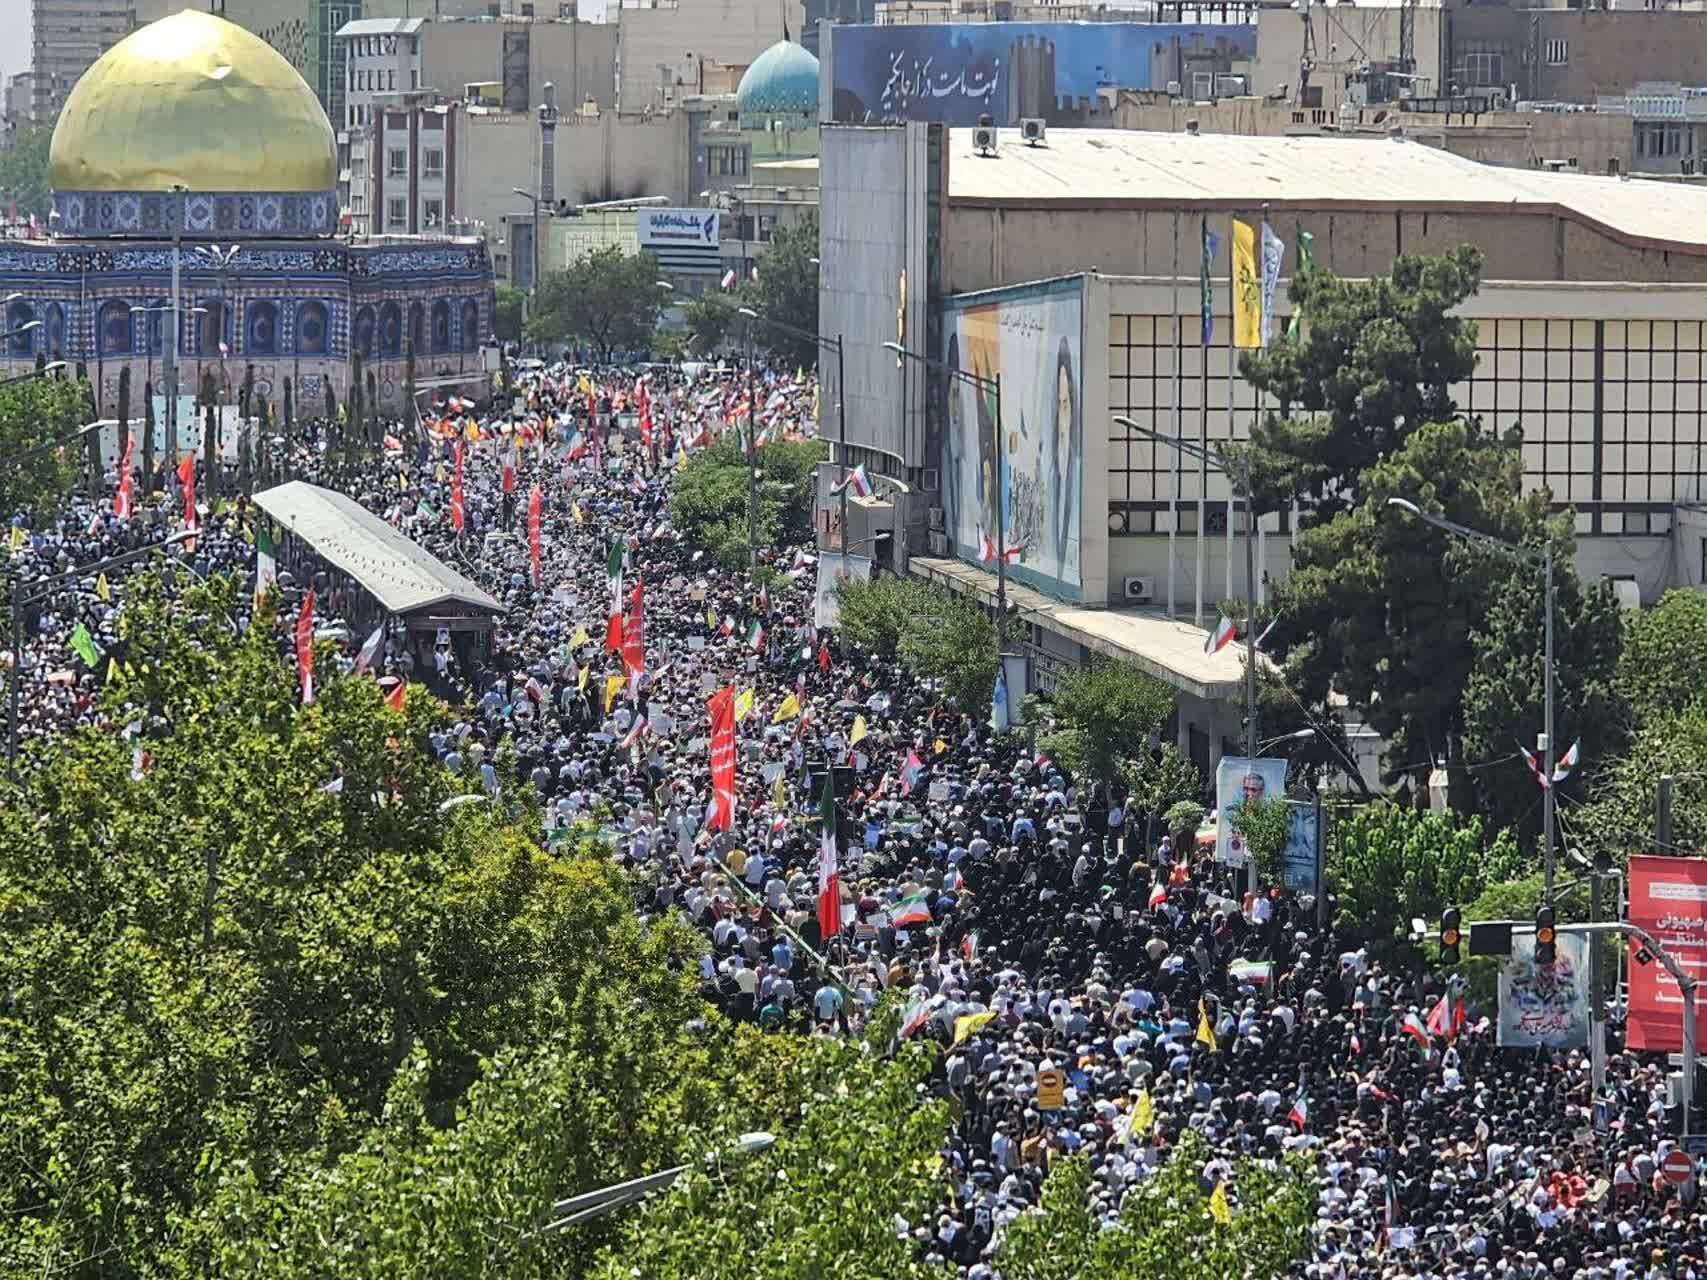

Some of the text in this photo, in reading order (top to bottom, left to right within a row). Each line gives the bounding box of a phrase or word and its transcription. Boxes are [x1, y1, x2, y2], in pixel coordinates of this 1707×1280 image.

[932, 66, 967, 98] ماست
[966, 57, 1001, 105] نوبت
[1656, 912, 1704, 931] صهیونی
